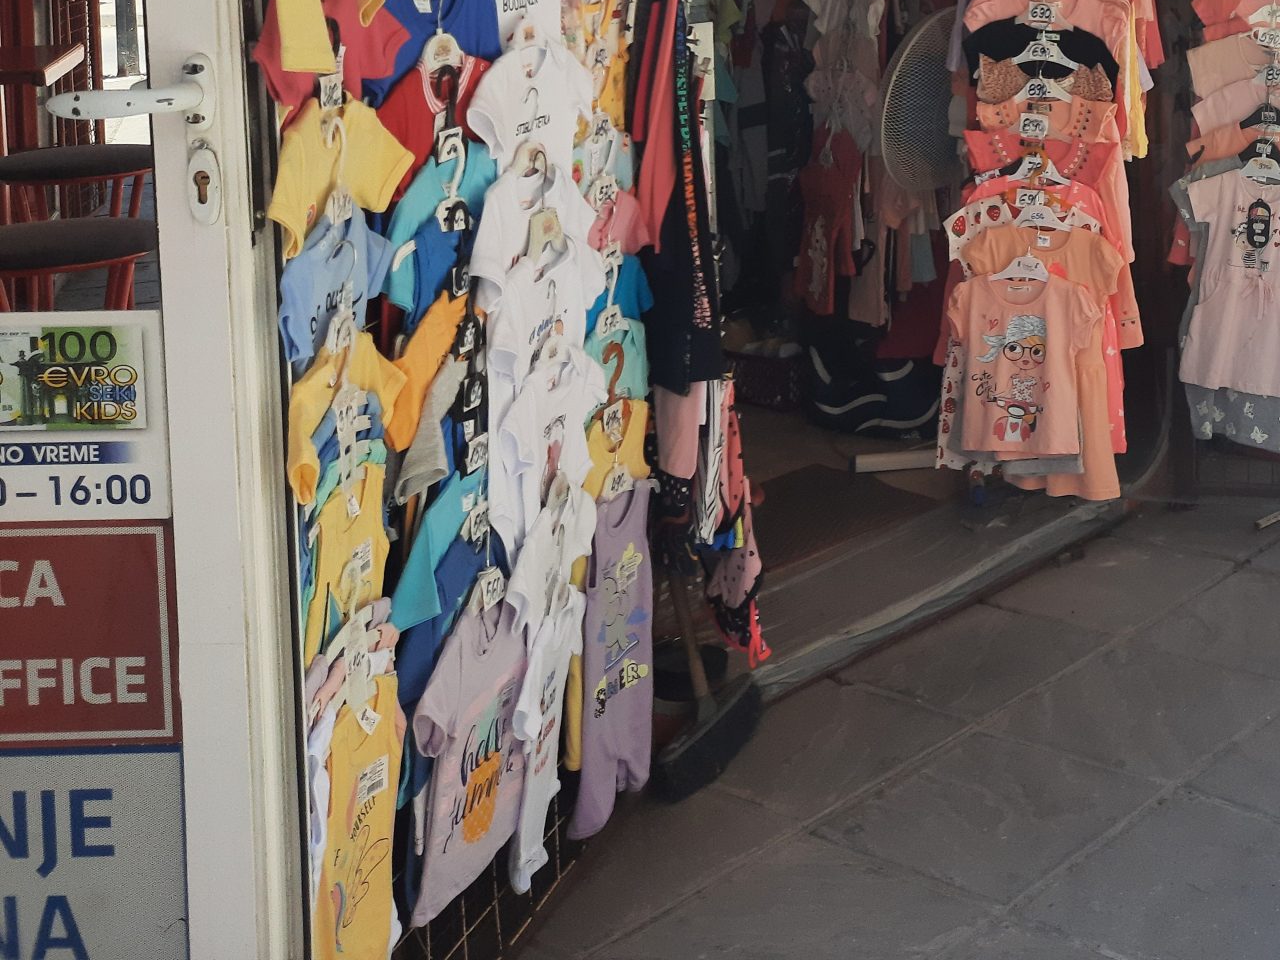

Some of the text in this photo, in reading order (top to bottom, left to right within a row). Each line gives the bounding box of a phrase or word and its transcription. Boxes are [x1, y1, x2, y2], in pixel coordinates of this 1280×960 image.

[40, 330, 118, 363] 100
[74, 400, 138, 422] KIDS
[32, 444, 100, 462] VREME
[349, 795, 377, 842] YOURSELF
